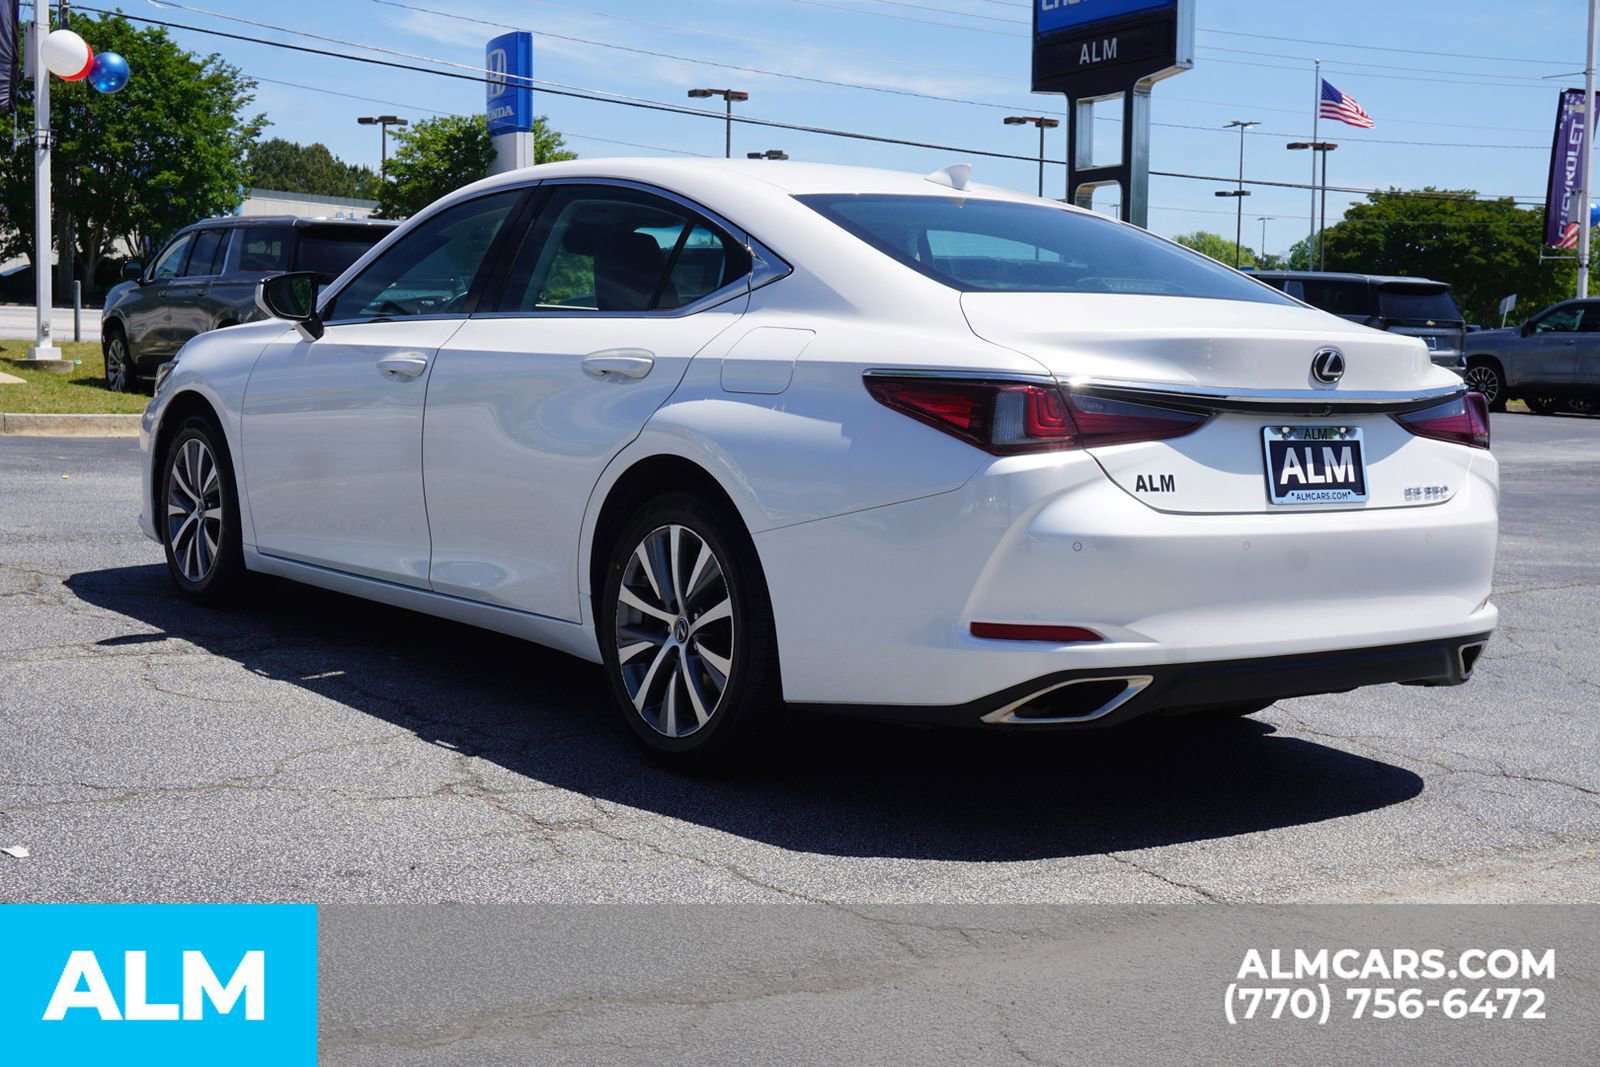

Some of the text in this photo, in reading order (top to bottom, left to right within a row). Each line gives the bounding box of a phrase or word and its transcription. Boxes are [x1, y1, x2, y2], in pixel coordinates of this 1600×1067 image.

[1079, 37, 1118, 64] ALM
[1304, 428, 1328, 440] ALM
[1280, 446, 1355, 485] ALM
[1135, 474, 1176, 492] ALM
[1296, 491, 1348, 501] ALMCARS.COM
